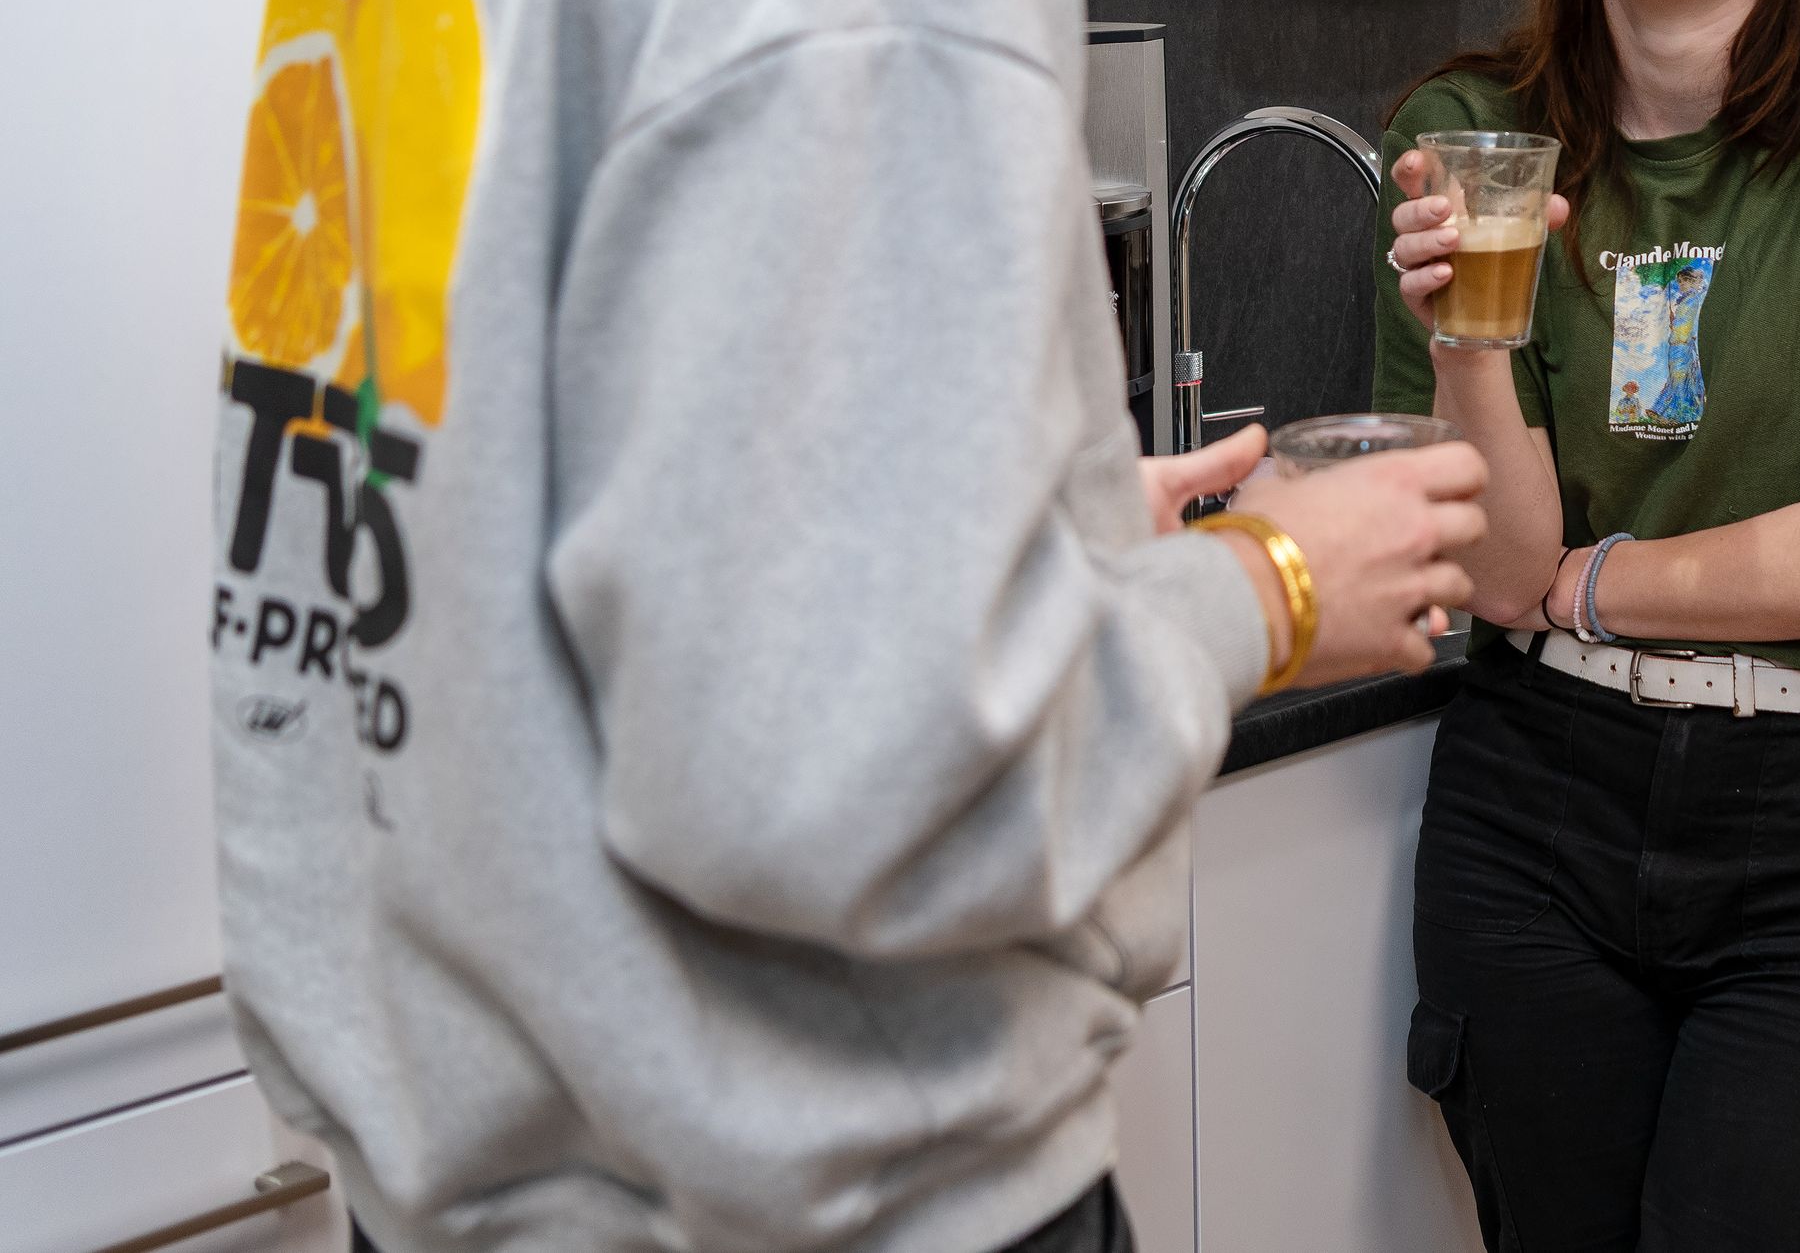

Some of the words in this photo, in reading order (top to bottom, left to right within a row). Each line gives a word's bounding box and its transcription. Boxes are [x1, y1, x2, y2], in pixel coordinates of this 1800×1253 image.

[1599, 245, 1672, 271] Claude
[1672, 241, 1726, 261] Mone
[1609, 424, 1646, 432] Madame
[1647, 424, 1674, 434] Monet
[1675, 424, 1690, 434] and
[1634, 431, 1667, 441] Woman
[1668, 433, 1687, 441] with
